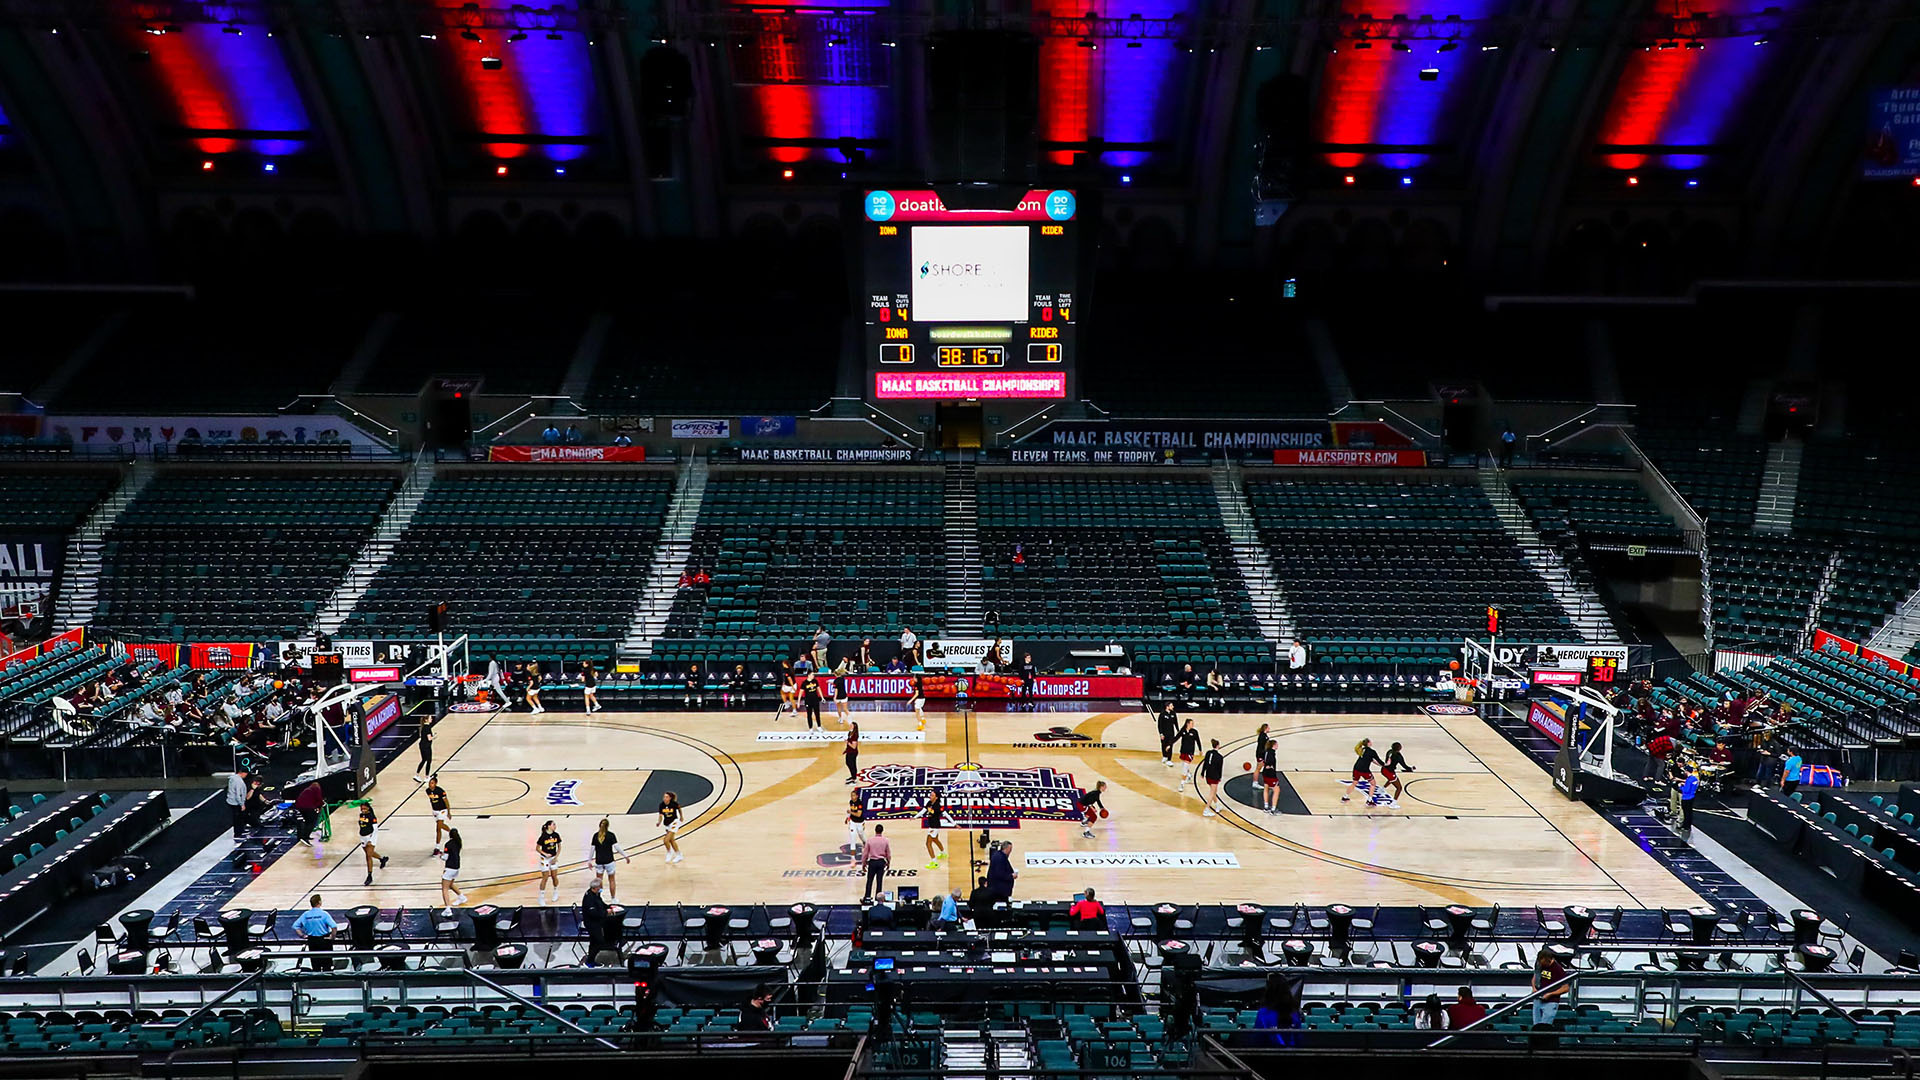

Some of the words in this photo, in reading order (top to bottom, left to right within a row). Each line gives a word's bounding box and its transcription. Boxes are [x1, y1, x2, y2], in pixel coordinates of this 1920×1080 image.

[1053, 196, 1068, 204] DO
[1053, 207, 1068, 215] AC
[879, 226, 897, 235] IONA
[1042, 226, 1064, 235] RIDER
[932, 264, 982, 276] SHORE
[879, 308, 891, 322] 0
[897, 308, 908, 321] 4
[1041, 307, 1052, 322] 0
[1059, 308, 1070, 321] 4
[886, 327, 909, 339] IONA
[1030, 327, 1059, 339] RIDER
[900, 345, 911, 362] 0
[941, 348, 988, 365] 38:16
[1047, 344, 1058, 362] 0
[882, 379, 912, 392] MAAC
[916, 379, 979, 392] BASKETBALL
[982, 379, 1060, 392] CHAMPIONSHIPS
[1053, 431, 1097, 446] MAAC
[1104, 431, 1197, 448] BASKETBALL
[1204, 431, 1323, 448] CHAMPIONSHIPS
[741, 450, 769, 461] MAAC
[773, 450, 832, 461] BASKETBALL
[836, 450, 911, 461] CHAMPIONSHIPS
[1012, 450, 1048, 462] ELEVEN
[1053, 450, 1090, 462] TEAMS.
[1094, 450, 1113, 462] ONE
[1117, 450, 1158, 463] TROPHY.
[1299, 451, 1398, 465] MAACSPORTS.COM
[346, 646, 371, 656] TIRES
[944, 645, 985, 655] HERCULES
[986, 645, 1011, 655] TES
[314, 655, 339, 665] 38:16
[1592, 657, 1617, 667] 38:16
[1593, 667, 1615, 682] 30
[1531, 708, 1565, 740] @MAACHOOPS
[1026, 858, 1171, 866] BOARDWALK
[1179, 858, 1238, 866] HALL
[782, 869, 866, 878] HERCULES
[886, 869, 918, 877] RES
[902, 1054, 919, 1065] 05
[1104, 1055, 1128, 1068] 106
